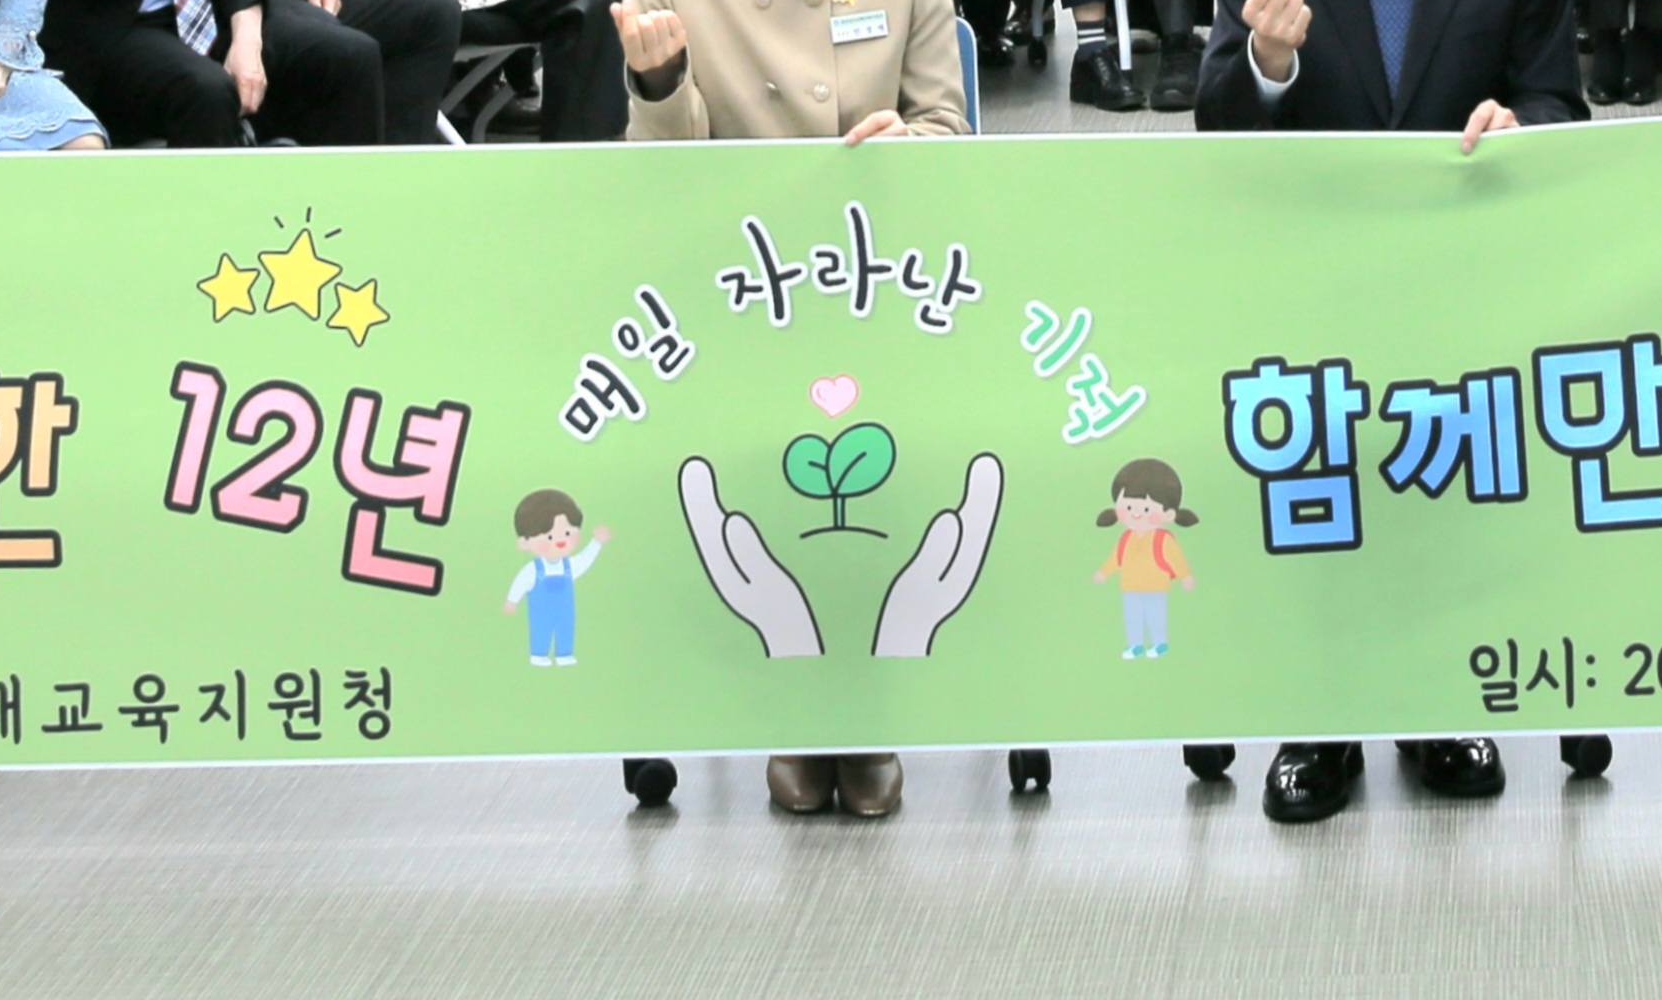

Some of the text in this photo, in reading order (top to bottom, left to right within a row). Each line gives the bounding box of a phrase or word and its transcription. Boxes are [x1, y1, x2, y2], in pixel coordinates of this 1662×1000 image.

[561, 204, 1144, 441] 매일 자라난 기적
[165, 361, 472, 596] 12년
[1469, 636, 1596, 712] 일시:
